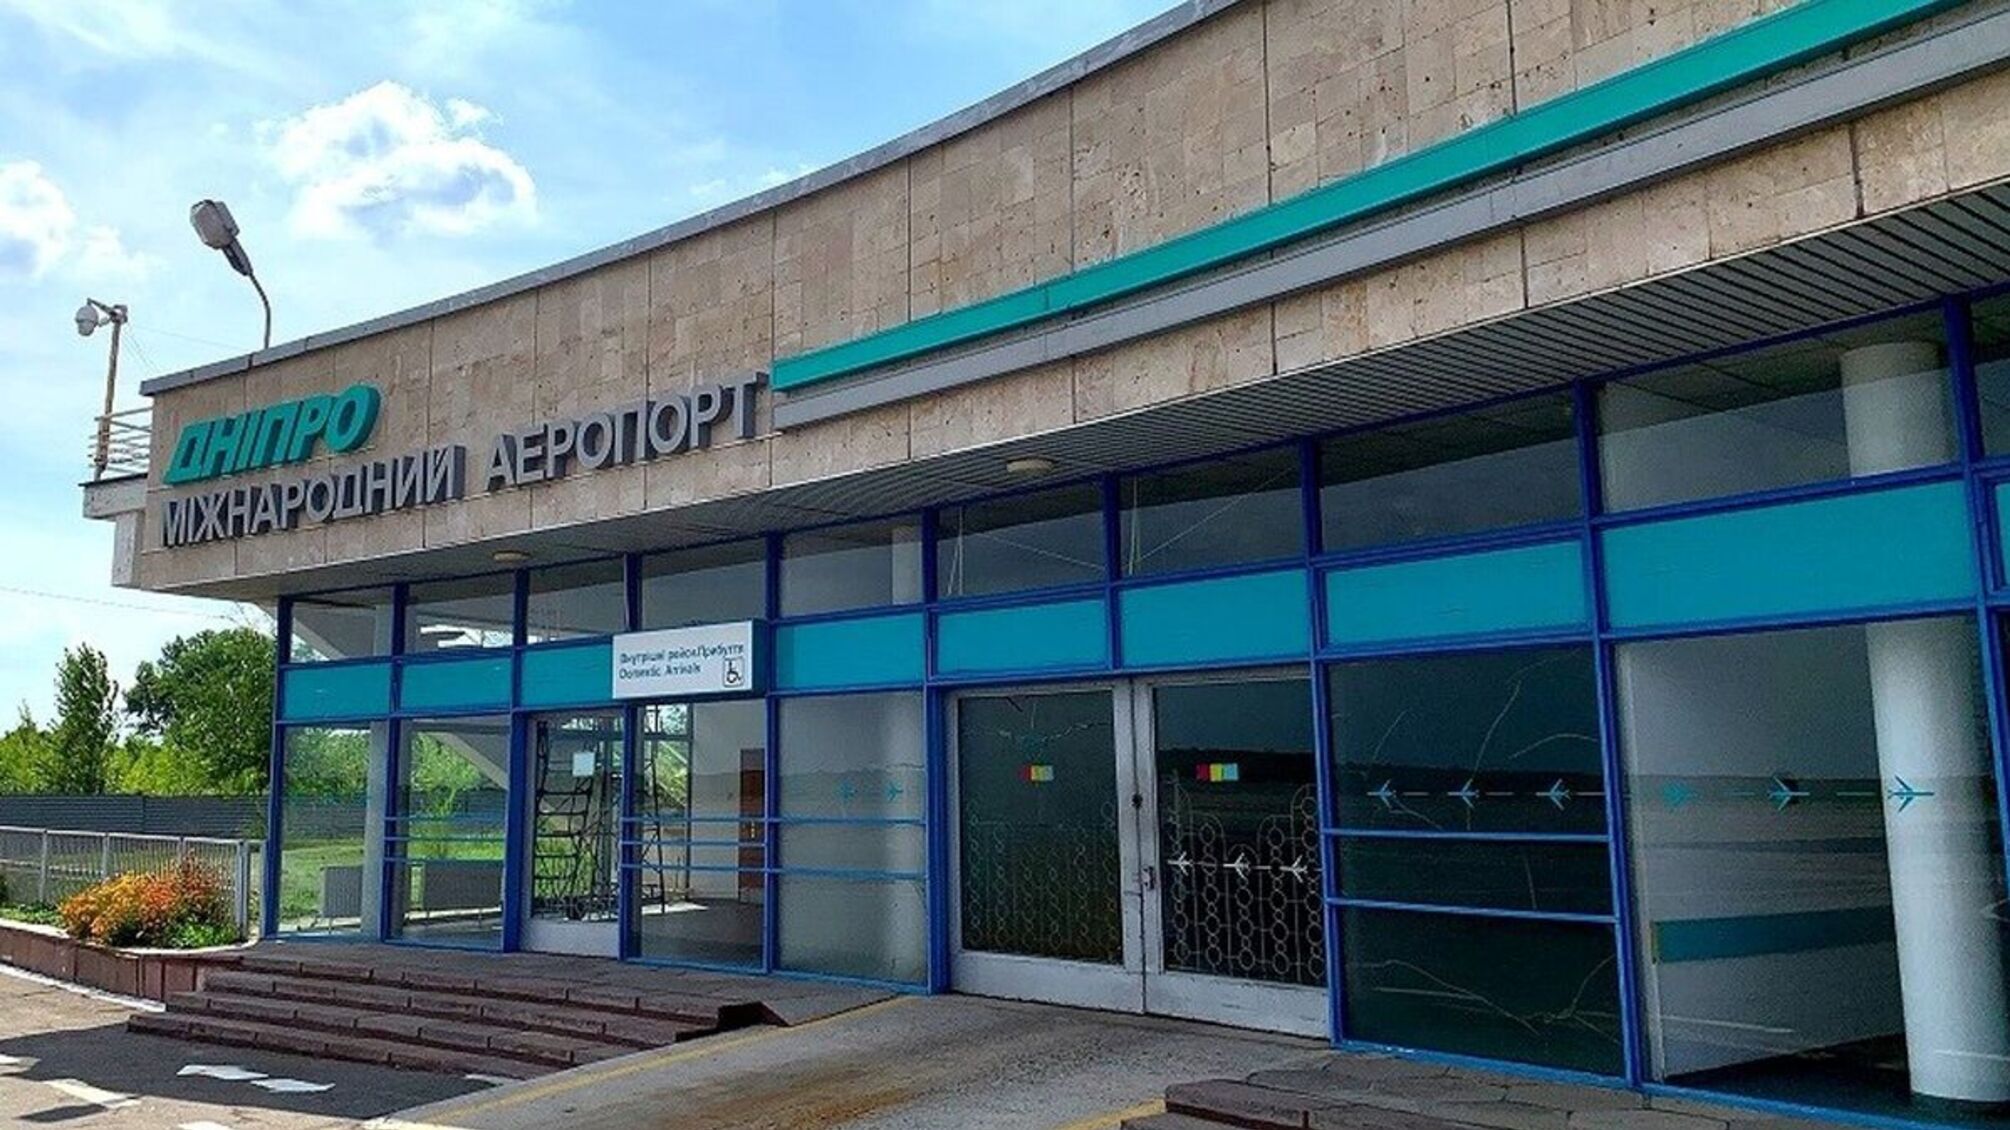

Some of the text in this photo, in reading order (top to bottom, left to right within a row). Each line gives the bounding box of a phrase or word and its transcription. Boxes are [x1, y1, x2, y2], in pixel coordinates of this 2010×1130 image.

[162, 372, 767, 548] МІЖНАРОДНИЙ АЕРОПОРТ
[163, 384, 381, 484] ДНІПРО
